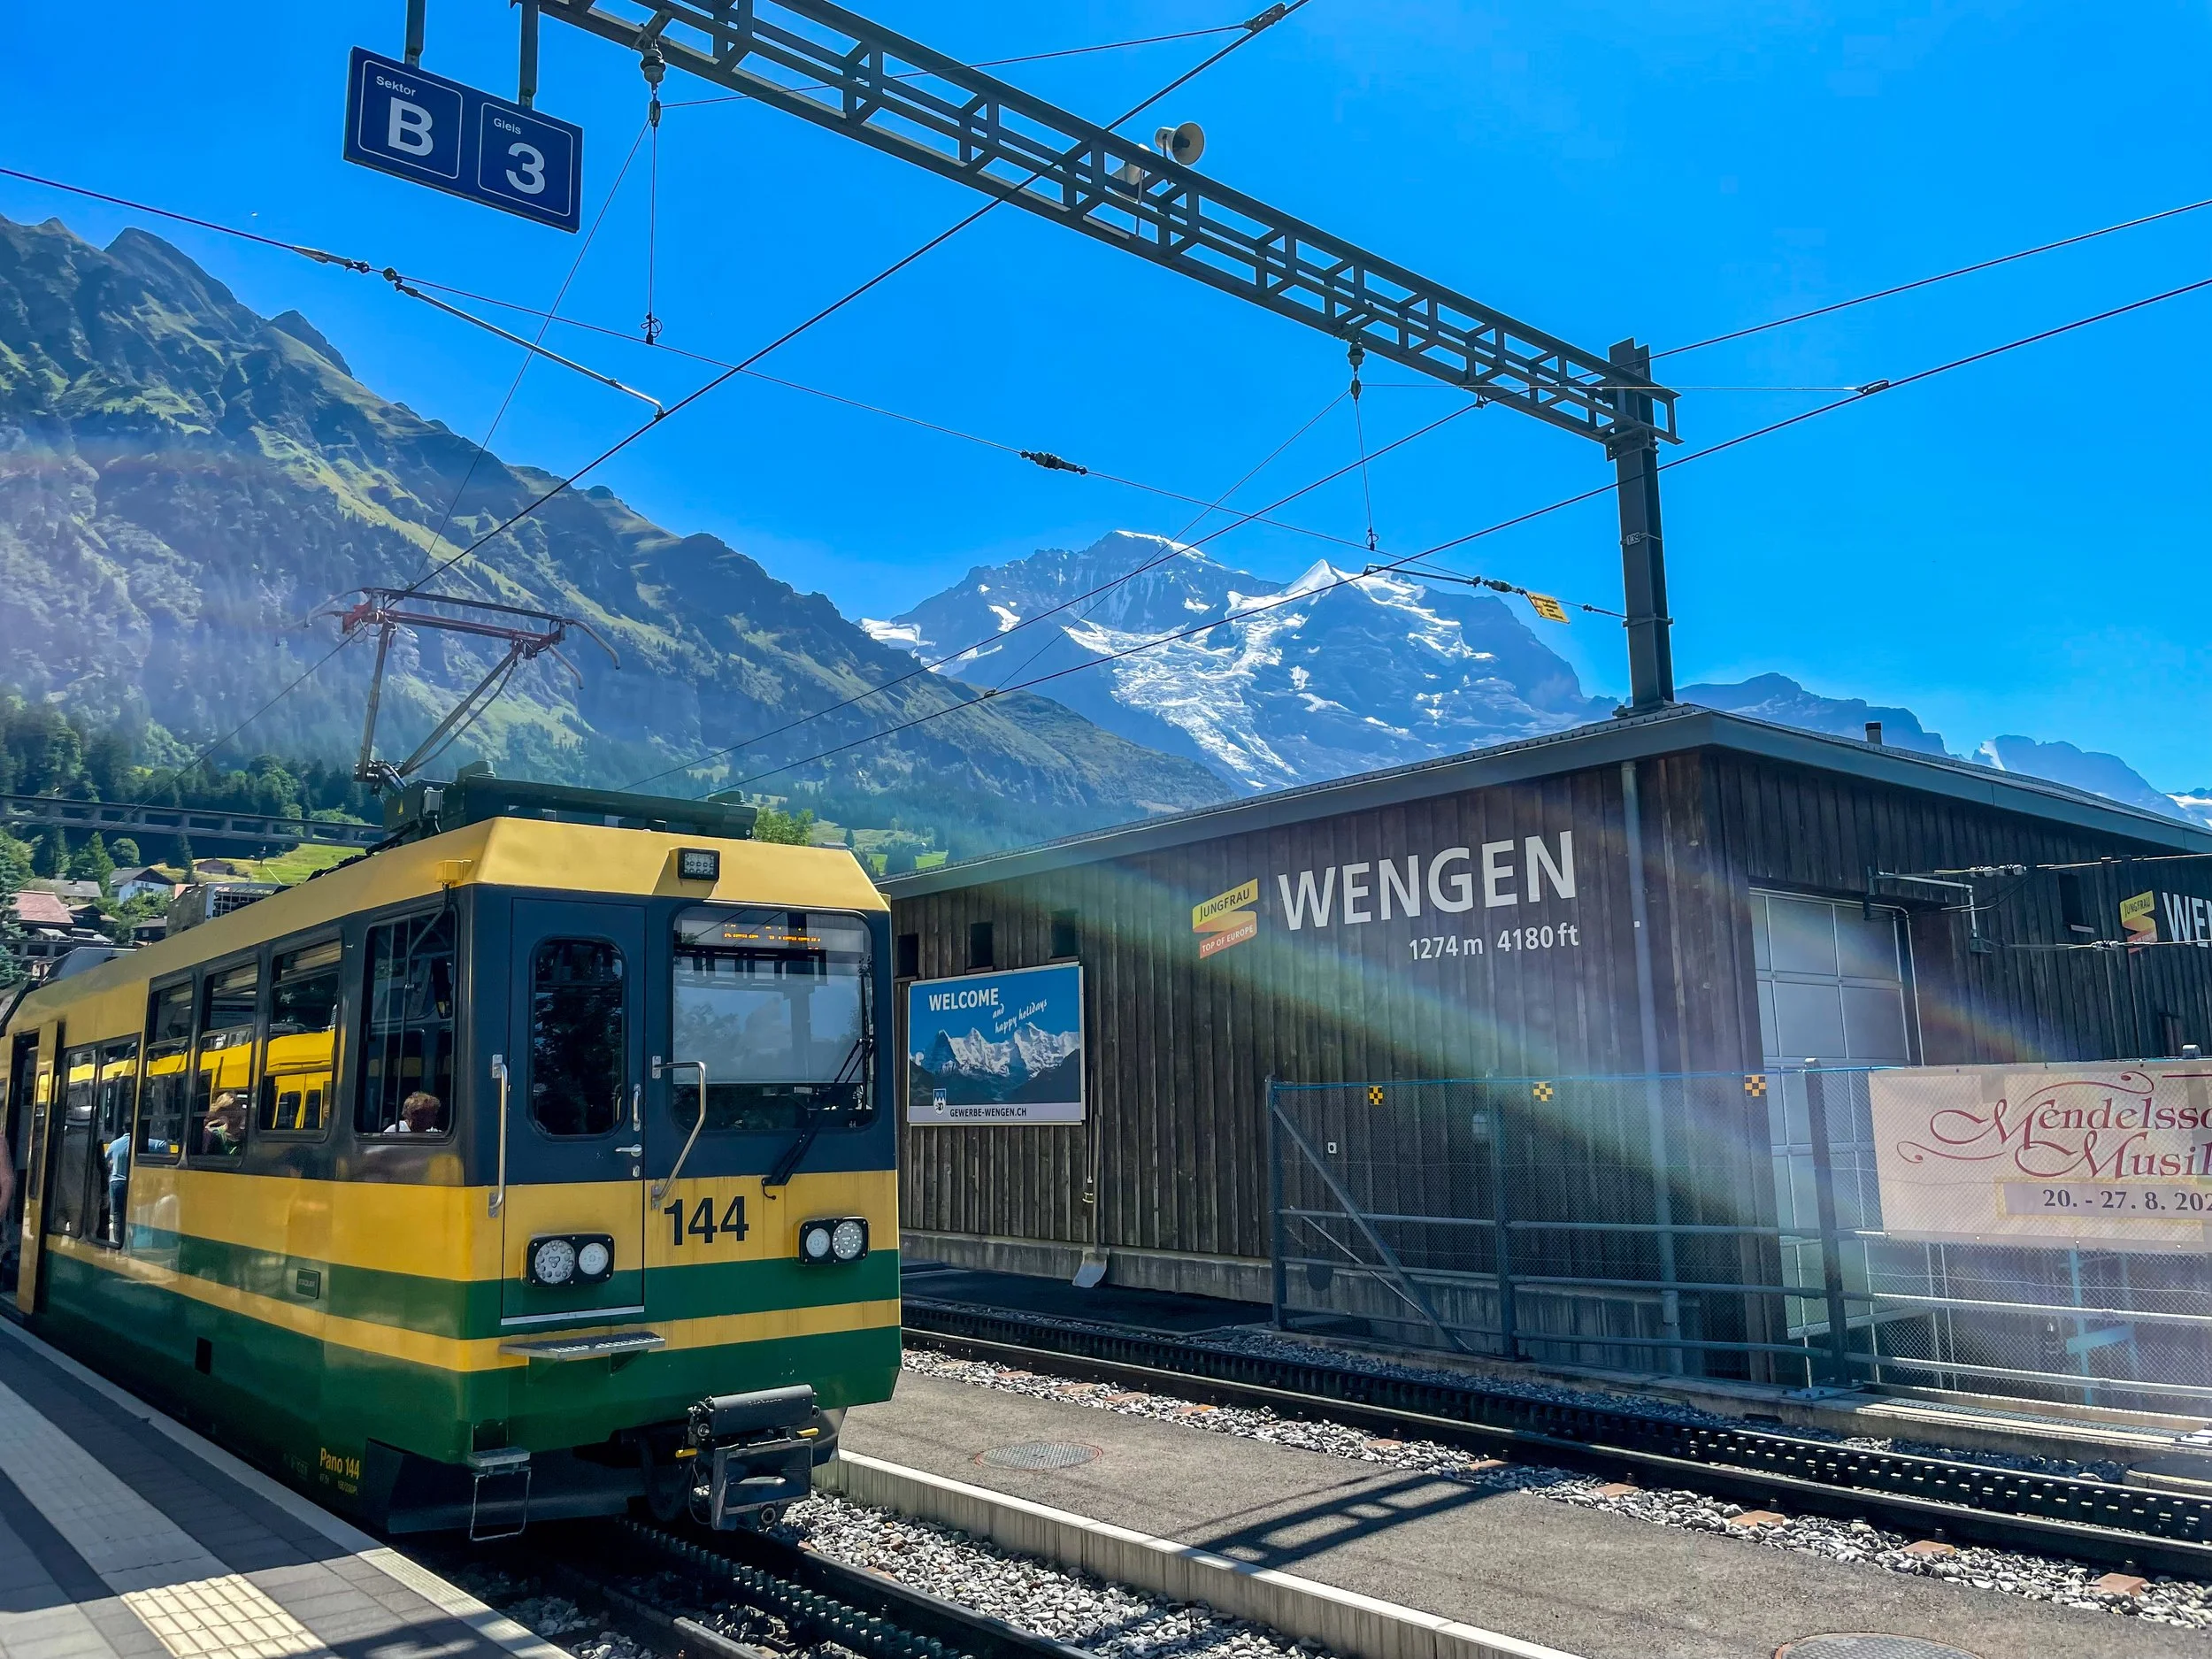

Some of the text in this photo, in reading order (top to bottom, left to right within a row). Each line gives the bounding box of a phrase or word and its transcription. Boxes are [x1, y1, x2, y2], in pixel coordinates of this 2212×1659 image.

[375, 75, 416, 97] Sektor
[388, 96, 434, 157] B
[493, 118, 522, 134] Gleis
[505, 142, 546, 195] 3
[1277, 830, 1577, 931] WENGEN
[1199, 887, 1250, 922] JUNGFRAU
[2124, 896, 2151, 918] JUNGFRAU
[1202, 925, 1254, 953] TOP OF EUROPE
[1409, 922, 1579, 960] 1274 m 4180 ft
[929, 987, 999, 1011] WELCOME
[992, 1002, 1005, 1019] and
[995, 998, 1048, 1034] happy holidays
[949, 1108, 1027, 1118] GEWERBE-WENGEN.CH
[664, 1195, 749, 1246] 144
[319, 1448, 343, 1473] Pano
[344, 1455, 360, 1480] 144
